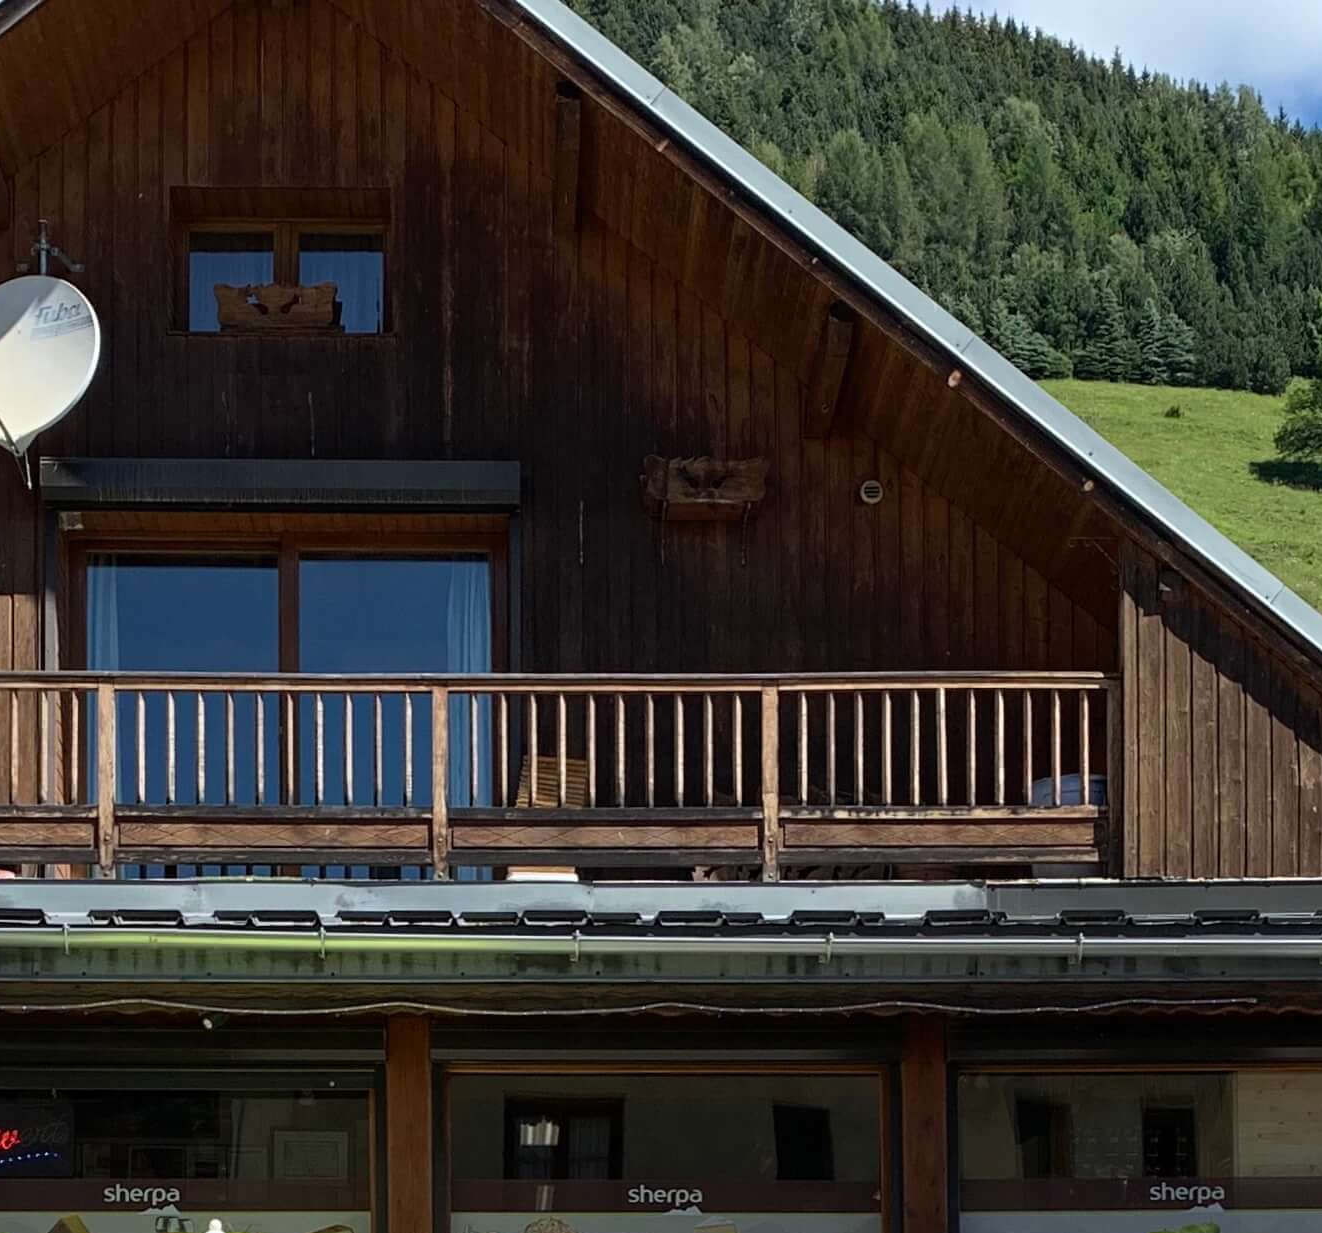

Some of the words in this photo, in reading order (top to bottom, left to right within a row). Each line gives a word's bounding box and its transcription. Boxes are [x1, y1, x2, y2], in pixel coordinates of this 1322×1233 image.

[103, 1184, 181, 1206] sherpa
[628, 1184, 704, 1206] sherpa
[1149, 1181, 1226, 1204] sherpa
